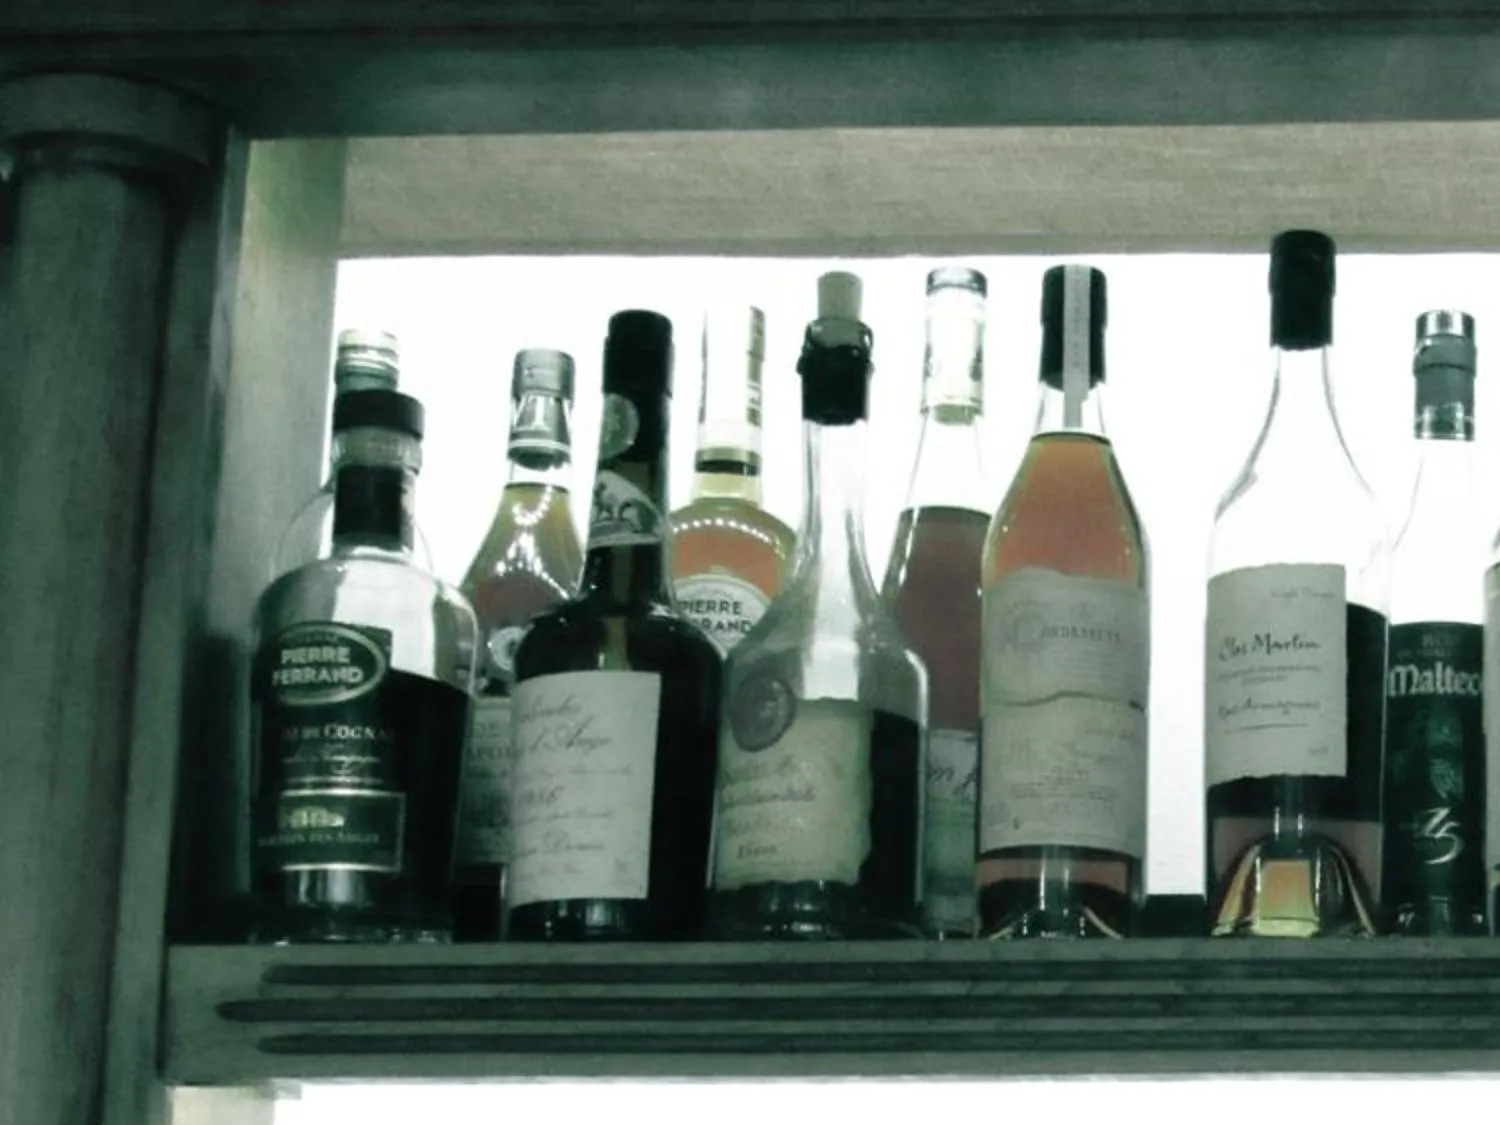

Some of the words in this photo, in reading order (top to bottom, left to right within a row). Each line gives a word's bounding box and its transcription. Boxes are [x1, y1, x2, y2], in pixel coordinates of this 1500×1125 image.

[678, 600, 743, 615] PIERRE
[281, 645, 351, 665] PIERRE
[271, 666, 364, 686] FERRAND
[1389, 661, 1482, 698] Maltec
